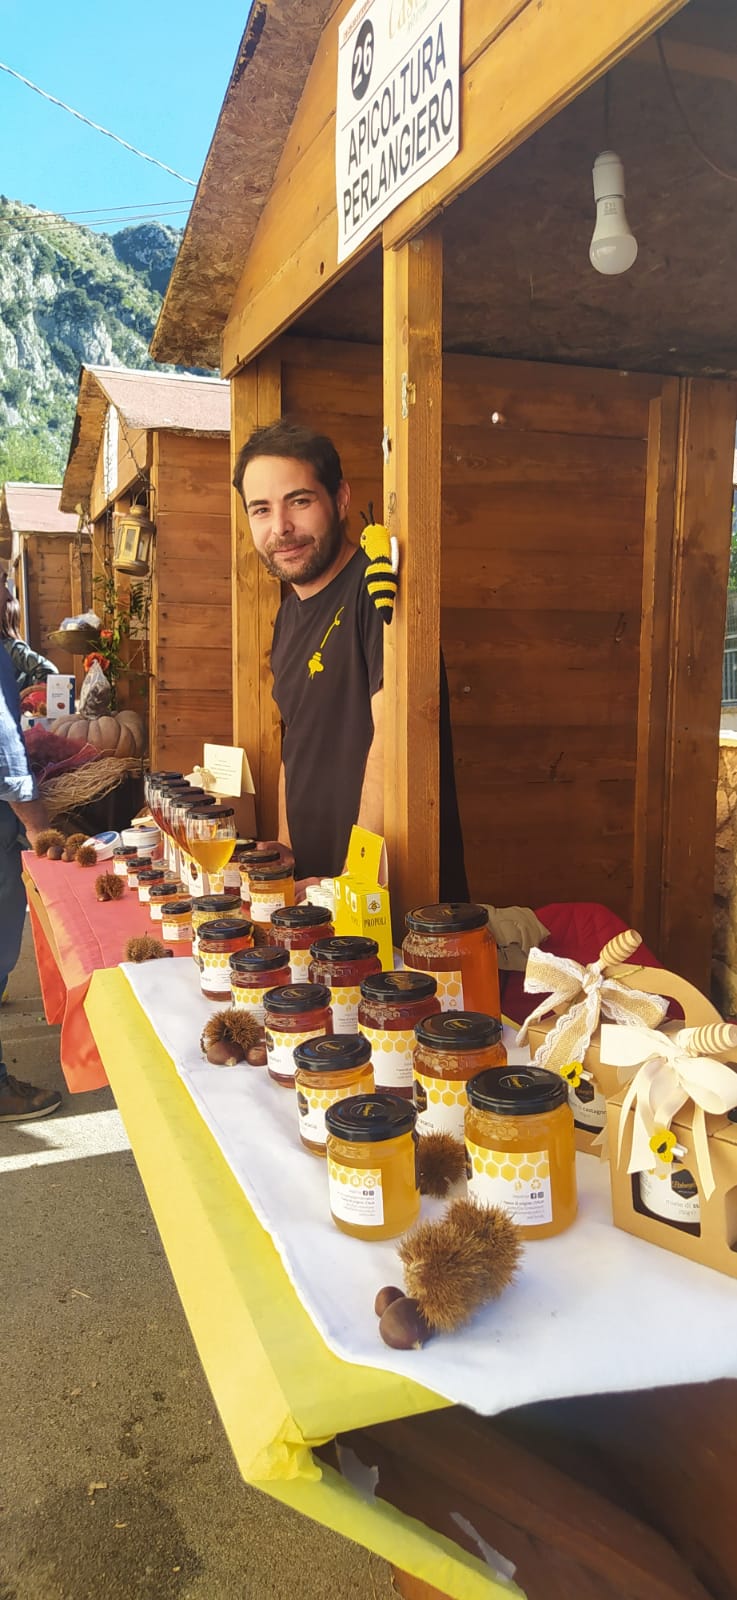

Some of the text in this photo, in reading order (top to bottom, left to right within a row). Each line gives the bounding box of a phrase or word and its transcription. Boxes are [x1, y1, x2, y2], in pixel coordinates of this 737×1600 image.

[348, 21, 446, 176] APICOLTURA
[353, 32, 372, 90] 26
[343, 78, 453, 235] PERLANGIERO
[364, 915, 387, 928] PROPOLI
